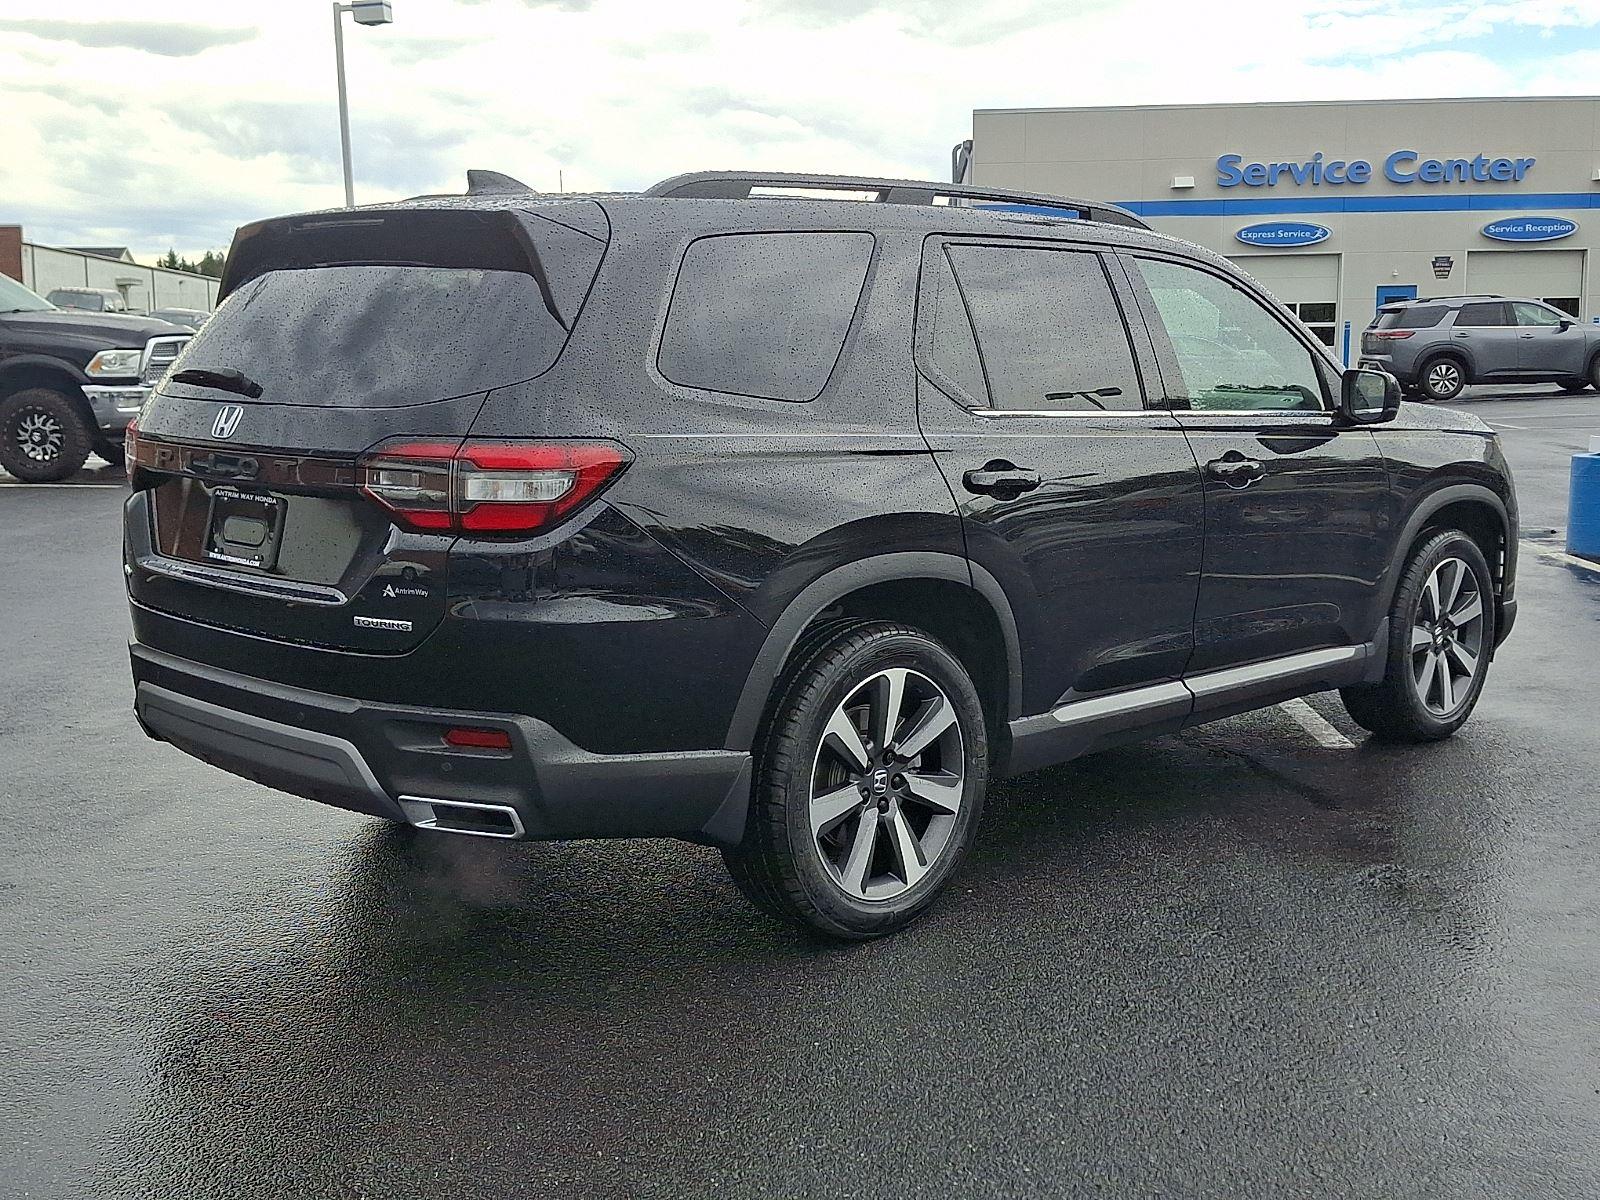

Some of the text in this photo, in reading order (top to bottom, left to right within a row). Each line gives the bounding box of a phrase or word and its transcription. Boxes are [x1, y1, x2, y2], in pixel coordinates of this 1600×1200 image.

[1216, 149, 1536, 188] Service Center
[1489, 222, 1572, 233] Service Reception
[1241, 229, 1311, 240] Express Service
[215, 490, 277, 504] ANTRIM WAY HONDA
[354, 618, 411, 631] TOURING
